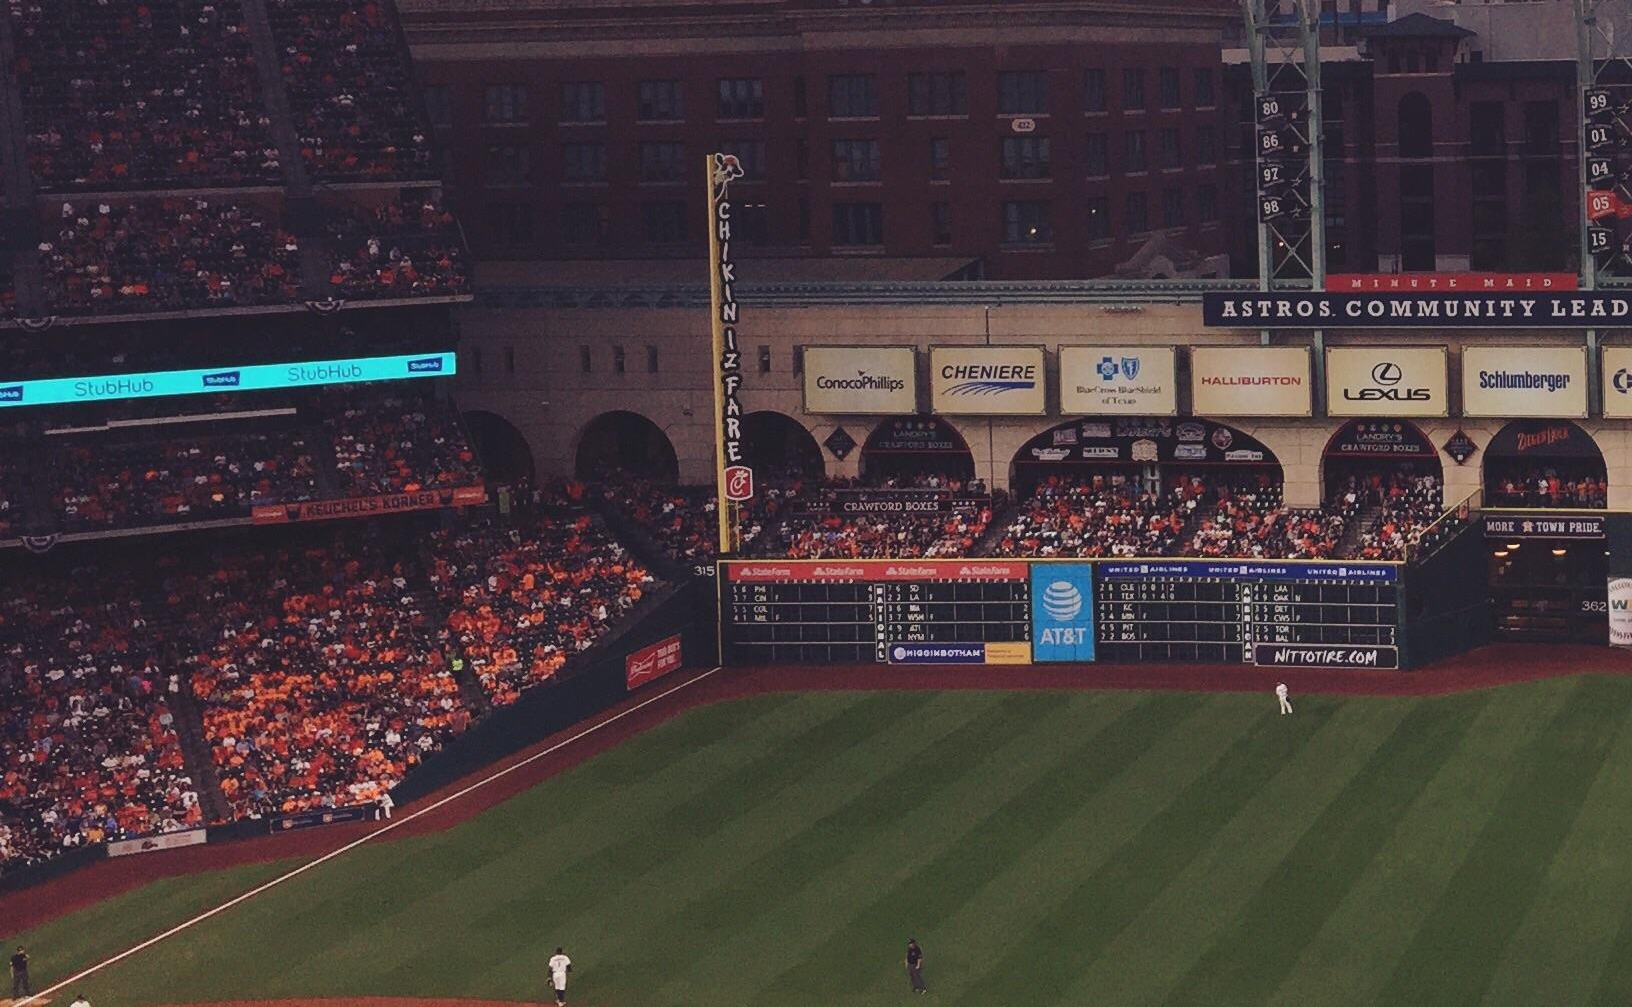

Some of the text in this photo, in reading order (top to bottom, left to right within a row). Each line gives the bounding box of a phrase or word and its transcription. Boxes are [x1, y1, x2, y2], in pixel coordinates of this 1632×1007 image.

[1263, 102, 1278, 115] 80
[1590, 95, 1607, 109] 99
[1263, 135, 1278, 148] 86
[1591, 129, 1607, 142] 01
[1264, 168, 1278, 181] 97
[1592, 162, 1608, 175] 04
[1264, 201, 1279, 214] 98
[1593, 197, 1609, 210] 05
[1591, 233, 1607, 246] 15
[1352, 278, 1552, 288] MINUTE MAID
[1346, 300, 1536, 317] COMMUNITY
[288, 364, 362, 382] StubHub
[941, 365, 1035, 379] CHENIERE
[74, 379, 154, 397] StubHub
[817, 375, 904, 393] ConocoPhillips
[1201, 377, 1301, 386] HALLIBURTON
[1479, 371, 1570, 392] Schlumberger
[1101, 396, 1110, 404] of
[1343, 388, 1431, 401] LEXUS
[843, 501, 939, 511] CRAWFORD BOXES
[1487, 522, 1515, 532] MORE
[1537, 522, 1565, 533] TOWN
[694, 565, 716, 577] 315
[910, 593, 920, 601] LA
[1581, 600, 1607, 612] 362
[1275, 625, 1290, 633] TOR
[1040, 627, 1086, 646] AT&T
[906, 649, 981, 658] HIGGINBOTHAM
[1275, 647, 1378, 666] NITTOTIRE.COM
